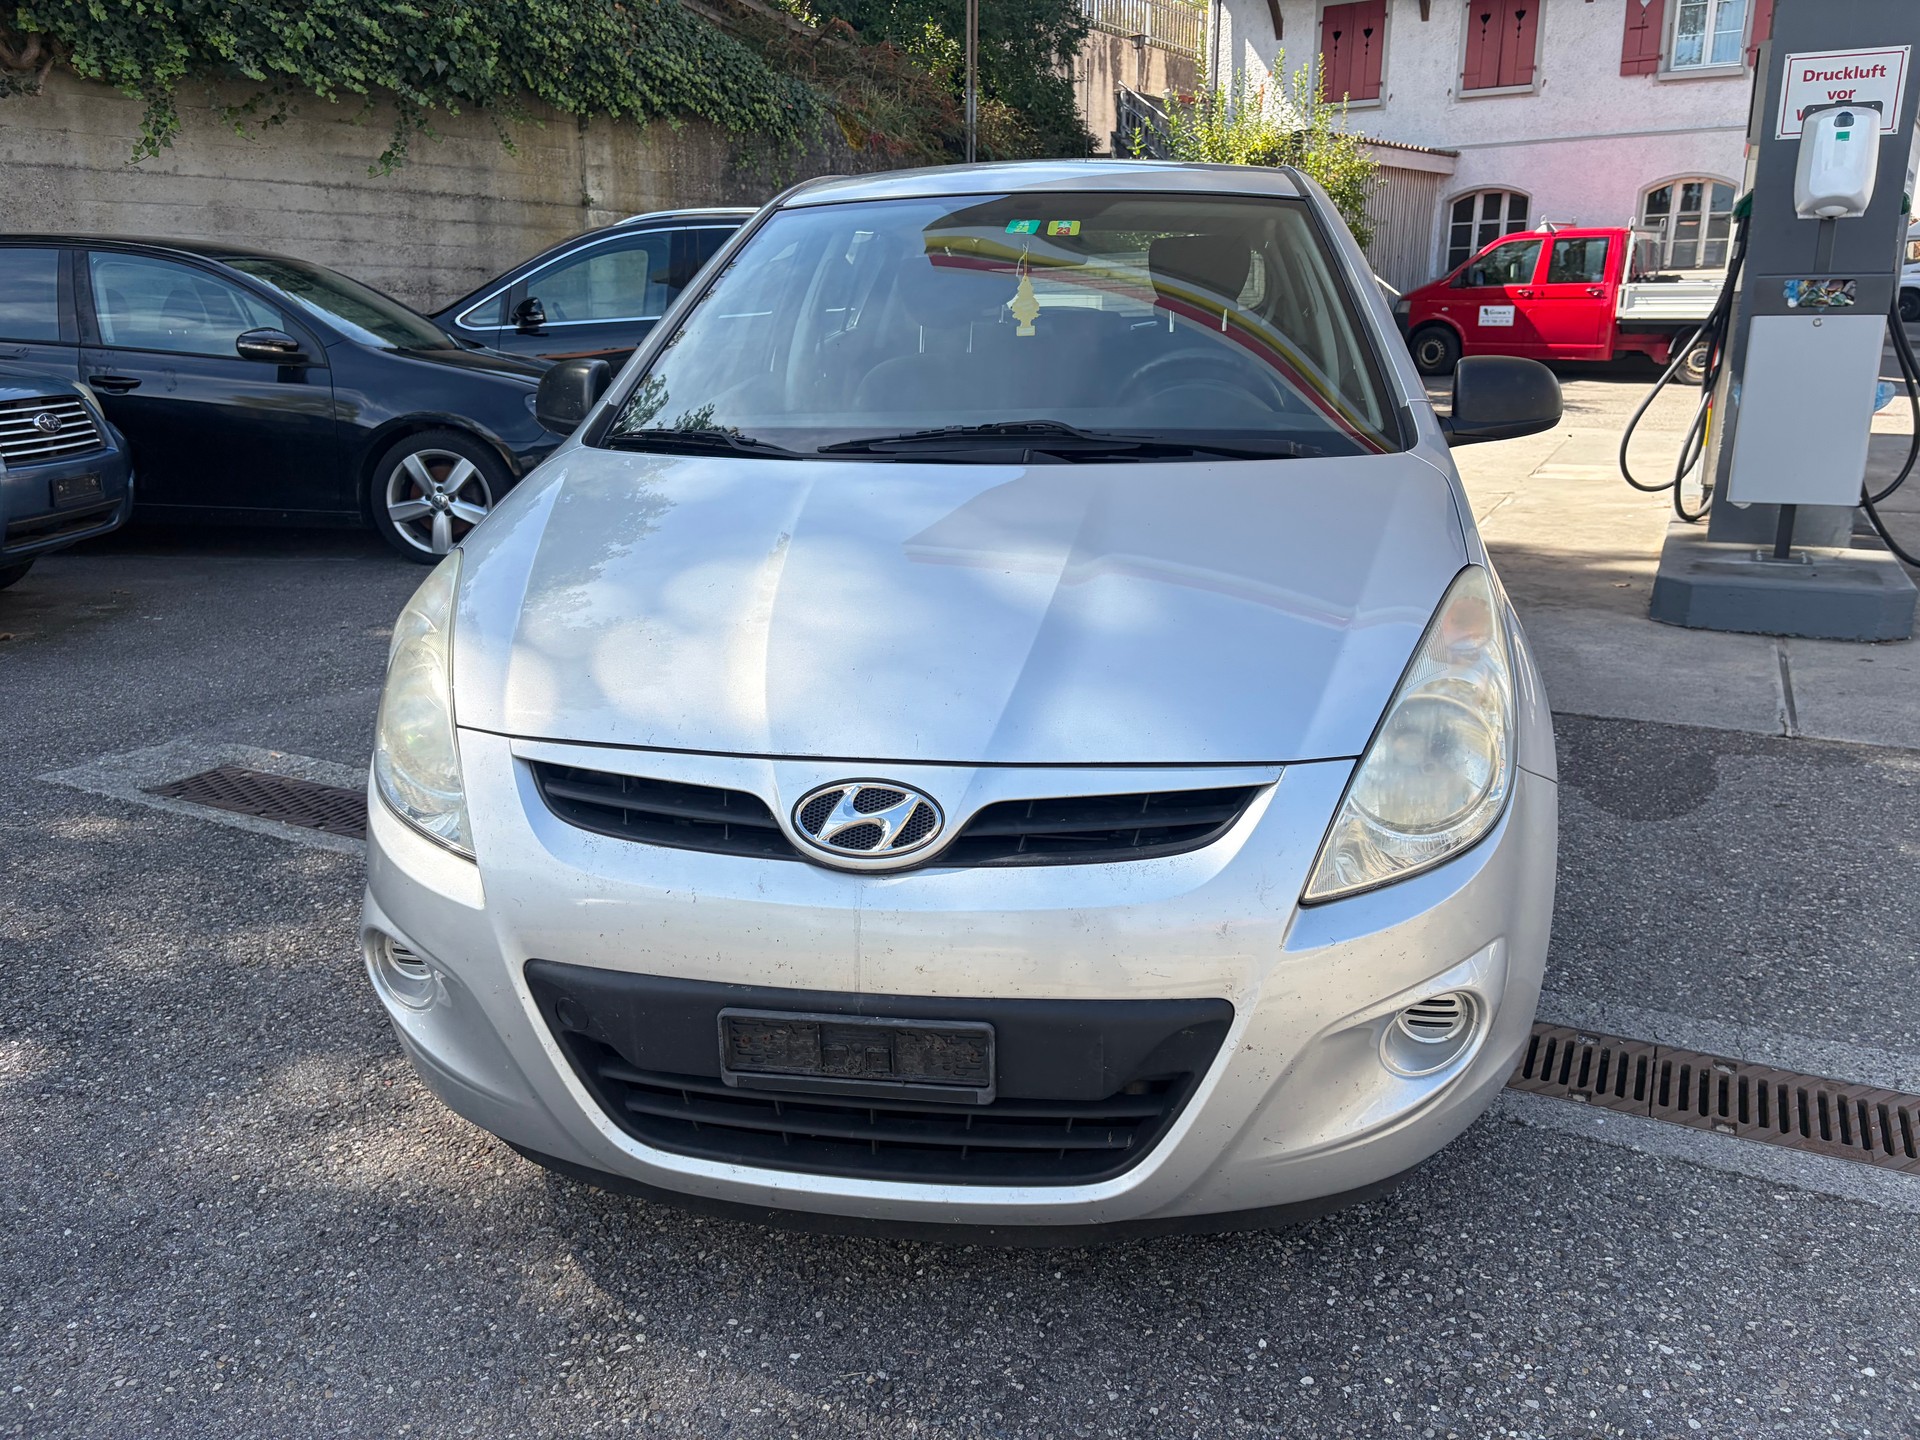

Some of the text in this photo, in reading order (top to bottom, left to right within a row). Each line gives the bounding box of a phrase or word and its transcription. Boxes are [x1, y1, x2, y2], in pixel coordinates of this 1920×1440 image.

[1802, 64, 1887, 82] Druckluft
[1827, 88, 1857, 100] vor
[1055, 227, 1071, 235] 23
